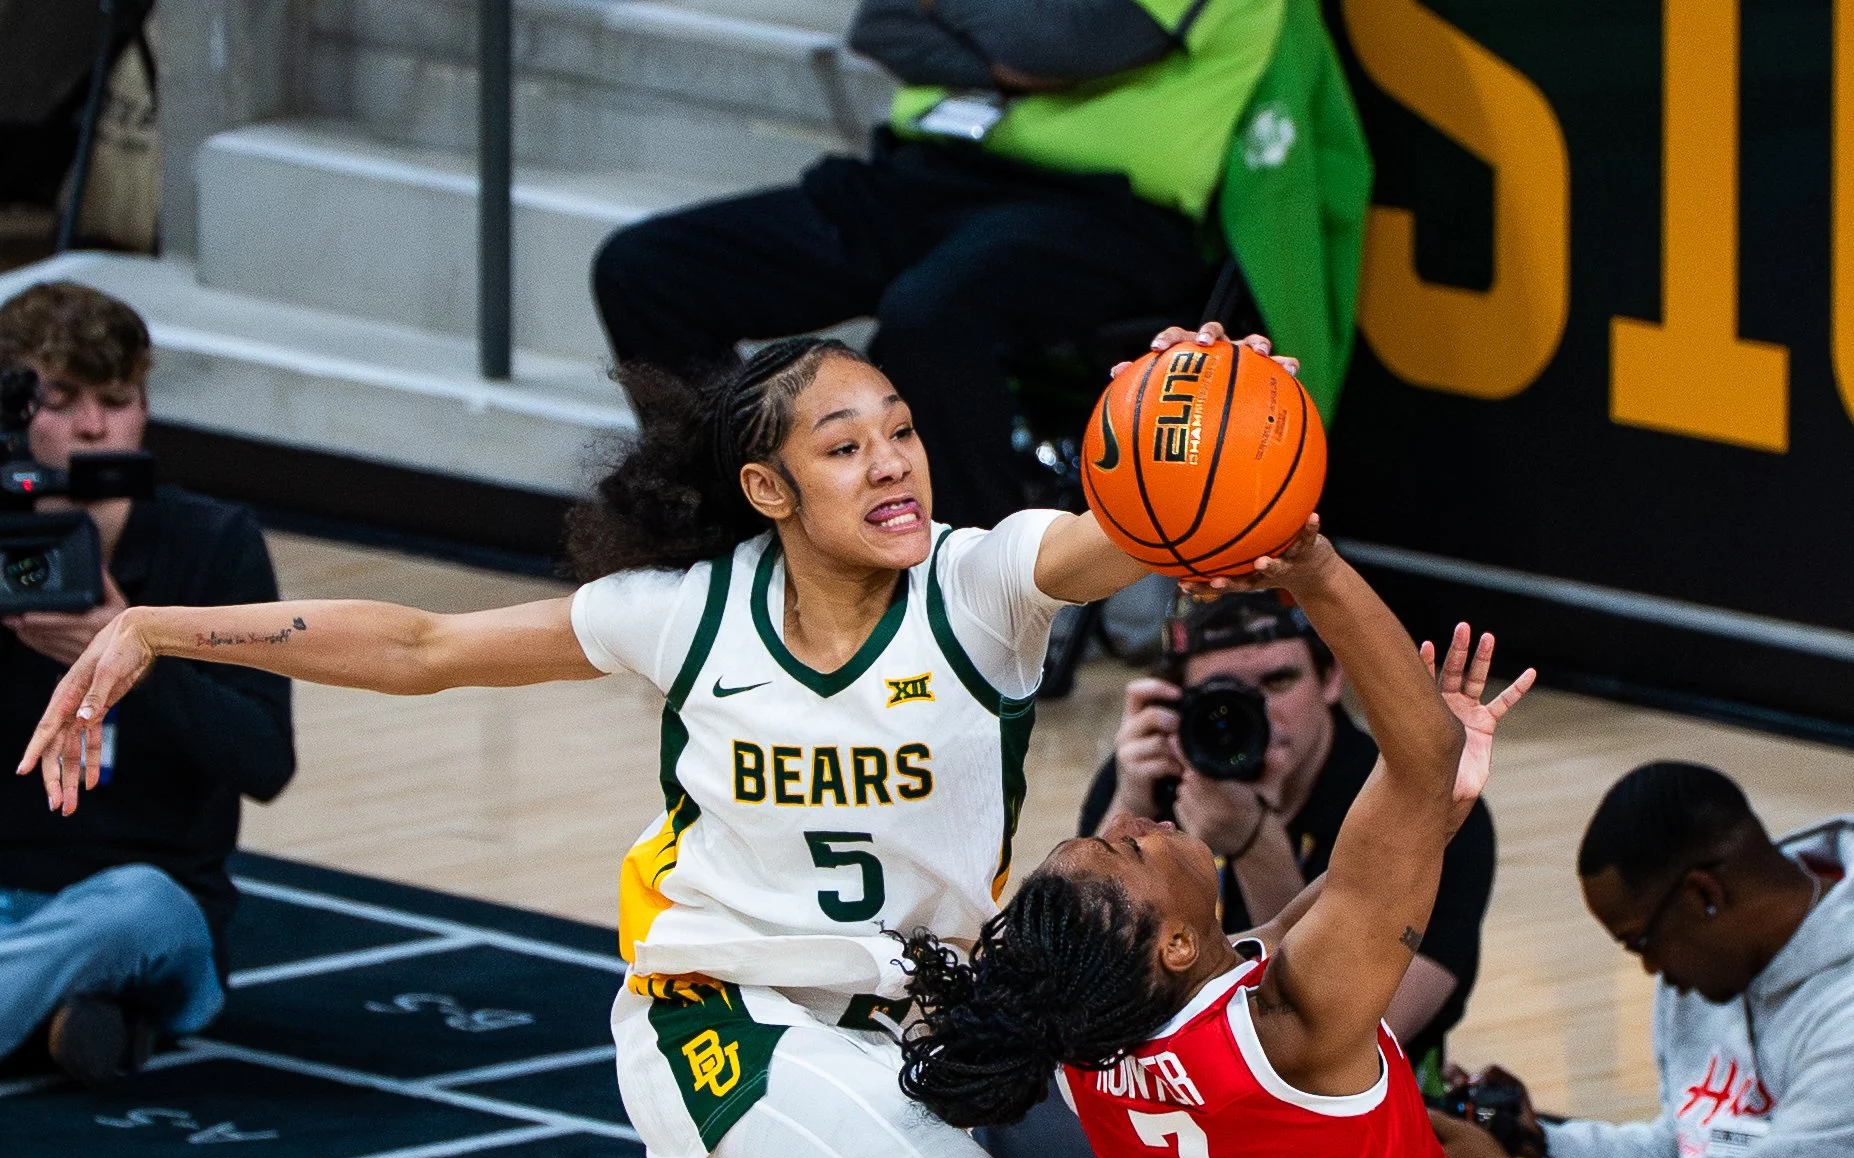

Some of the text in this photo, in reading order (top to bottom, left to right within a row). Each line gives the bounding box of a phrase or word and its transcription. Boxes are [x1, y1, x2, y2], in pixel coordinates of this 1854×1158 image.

[1342, 0, 1854, 455] SI
[1153, 350, 1209, 465] ELITE
[884, 671, 936, 708] XII
[732, 738, 934, 807] BEARS
[803, 831, 886, 923] 5
[681, 1029, 741, 1097] BU
